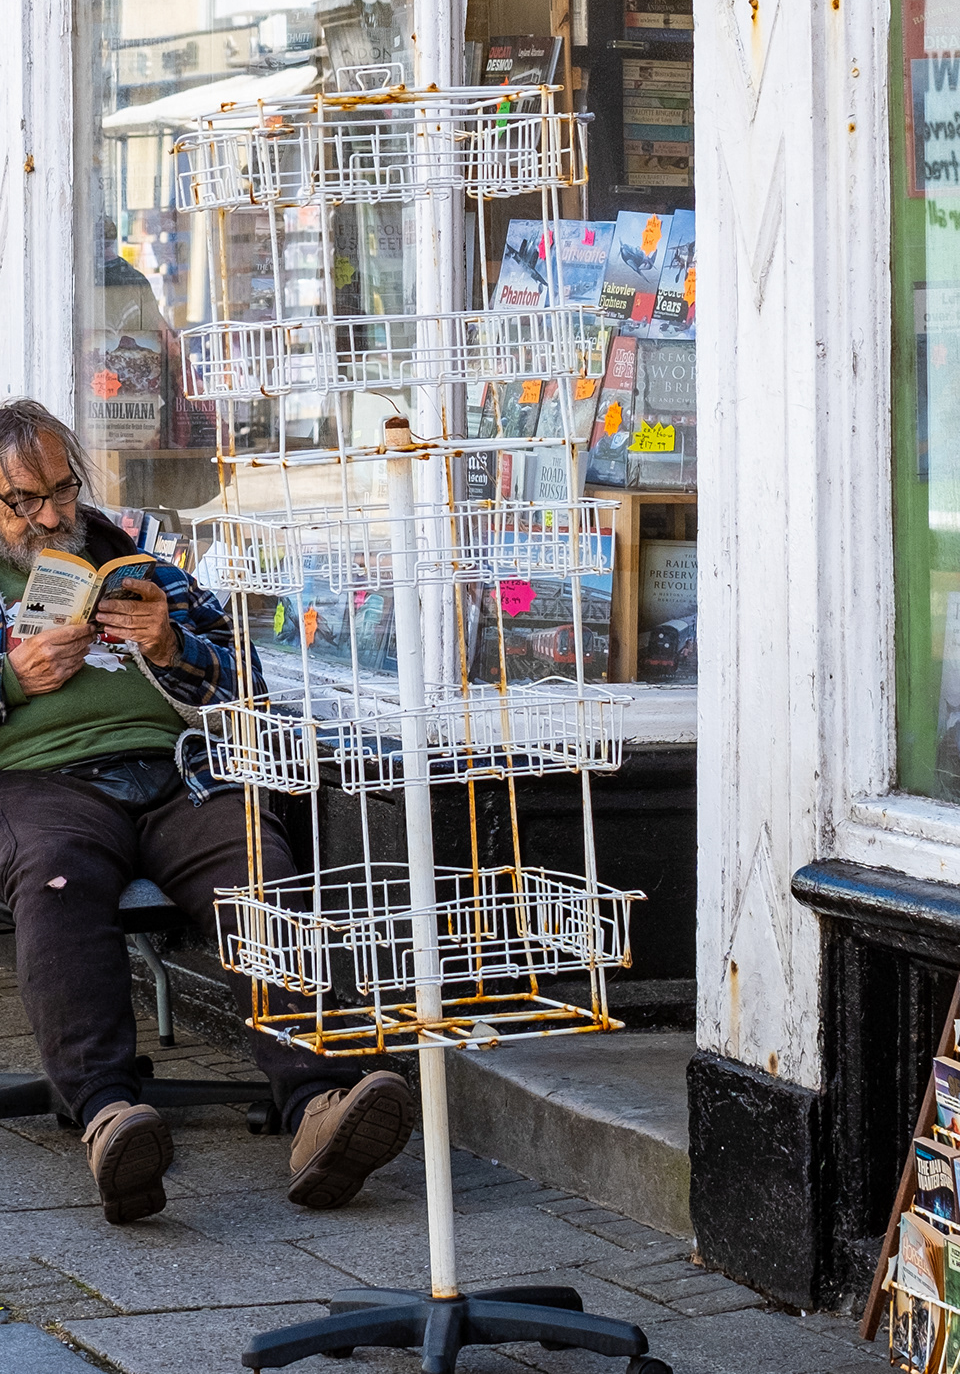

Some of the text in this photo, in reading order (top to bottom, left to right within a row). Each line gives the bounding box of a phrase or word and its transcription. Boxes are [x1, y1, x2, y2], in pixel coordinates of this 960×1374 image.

[488, 46, 512, 59] DUCATI
[500, 285, 541, 307] Phantom
[603, 281, 636, 297] Yakovlev
[655, 296, 682, 314] Years
[87, 400, 155, 420] ISANDLWANA
[552, 456, 563, 467] THE
[541, 466, 565, 482] ROAD
[649, 569, 698, 579] PRESERV
